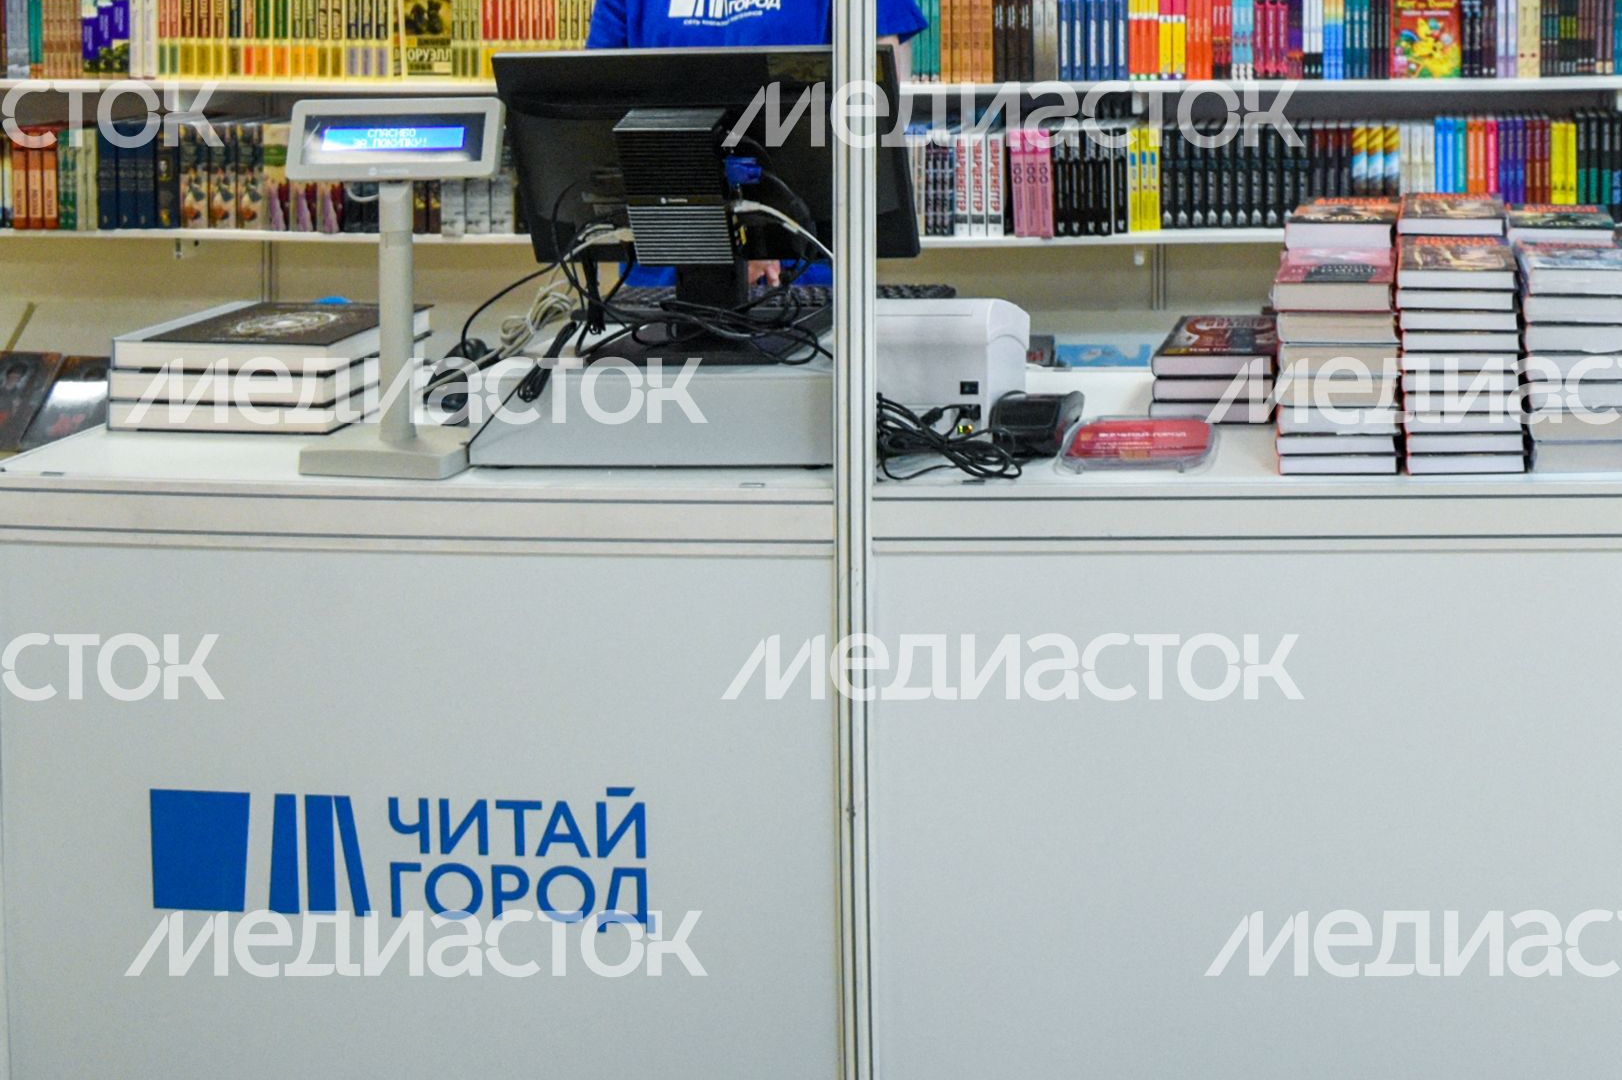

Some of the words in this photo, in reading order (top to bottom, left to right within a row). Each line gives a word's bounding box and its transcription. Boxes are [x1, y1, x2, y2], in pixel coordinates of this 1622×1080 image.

[407, 48, 452, 61] ОРУЭЛЛ
[367, 128, 417, 138] СПАСИБО
[387, 786, 648, 860] ЧИТАЙ
[389, 861, 656, 934] ГОРОД
